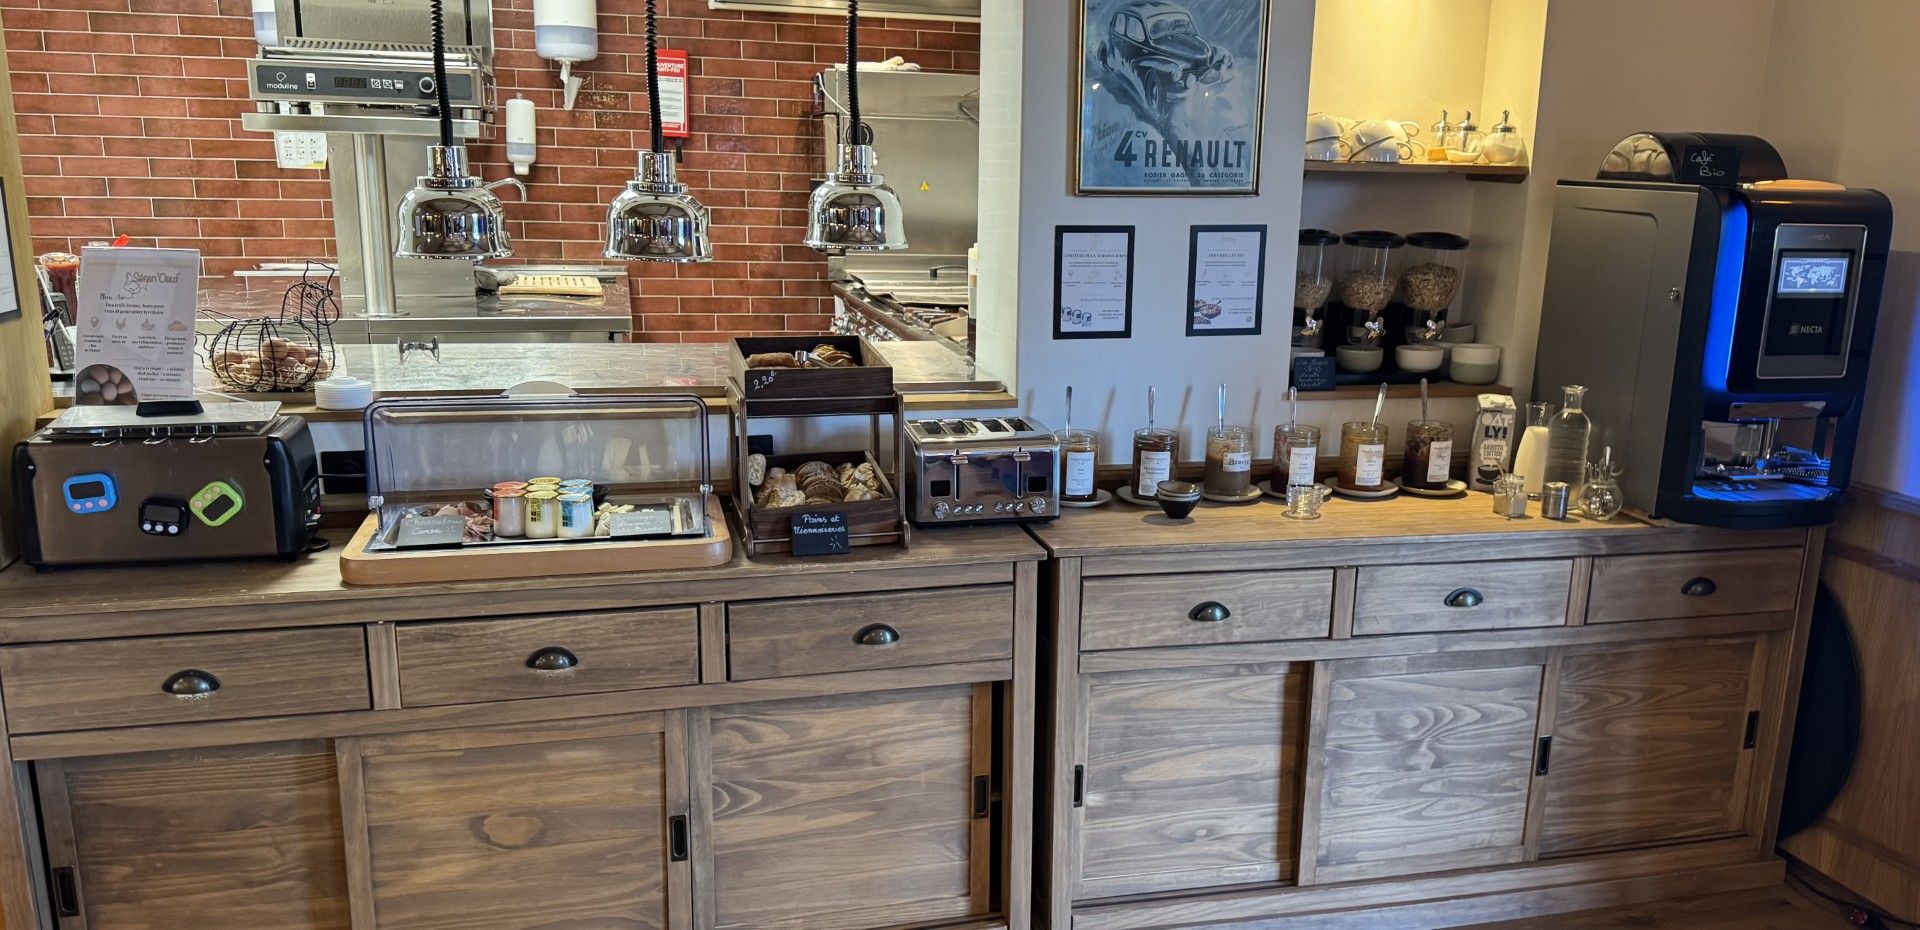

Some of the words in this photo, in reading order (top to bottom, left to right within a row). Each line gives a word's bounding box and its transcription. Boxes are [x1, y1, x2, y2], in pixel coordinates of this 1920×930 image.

[266, 82, 298, 90] moduline
[1113, 131, 1138, 167] 4
[1135, 130, 1148, 138] CV
[1144, 140, 1246, 168] RENAULT
[1690, 151, 1715, 165] Café
[1700, 165, 1726, 177] Bio
[1800, 326, 1823, 334] NECTA
[1484, 426, 1508, 438] LY!
[802, 514, 828, 523] Pains
[830, 514, 840, 523] et
[793, 525, 846, 534] Viennoiseries
